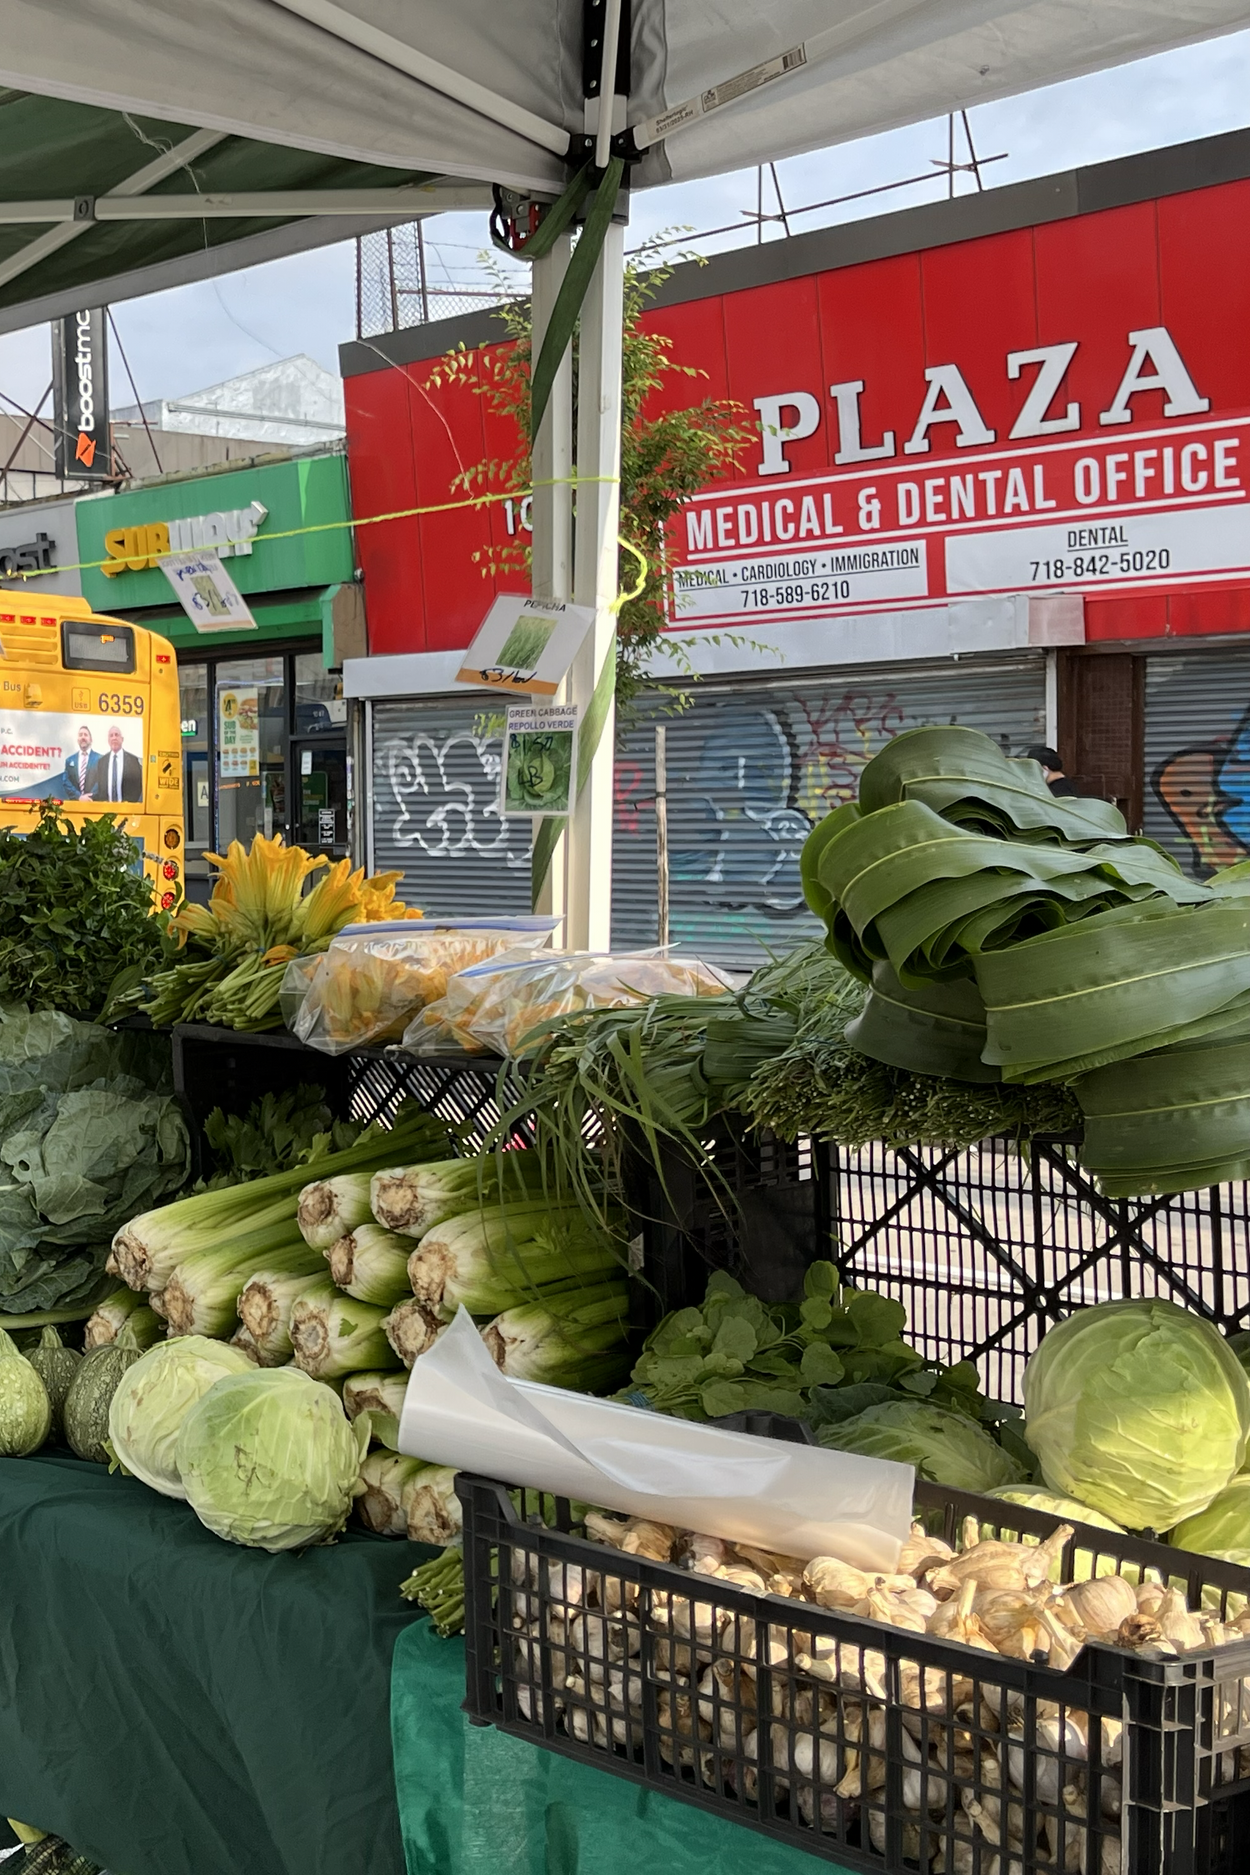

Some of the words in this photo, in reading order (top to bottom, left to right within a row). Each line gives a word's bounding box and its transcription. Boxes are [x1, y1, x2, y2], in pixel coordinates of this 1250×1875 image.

[753, 325, 1211, 476] PLAZA
[686, 493, 843, 551] MEDICAL
[858, 487, 881, 531] &
[897, 465, 1056, 525] DENTAL
[1074, 438, 1241, 504] OFFICE
[101, 500, 268, 578] SUBWAY
[1067, 525, 1128, 548] DENTAL
[678, 568, 729, 589] MEDICAL
[741, 559, 817, 582] CARDIOLOGY
[830, 547, 919, 573] IMMIGRATION
[1030, 549, 1170, 581] 718-842-5020
[741, 580, 850, 608] 718-589-6210
[3, 681, 21, 692] Bus
[98, 693, 144, 715] 6359
[509, 707, 536, 718] GREEN
[538, 705, 577, 717] CABBAGE
[509, 721, 545, 730] REPOLLO
[547, 720, 574, 729] VERDE
[1, 744, 62, 758] ACCIDENT?
[224, 736, 236, 745] DAY
[9, 761, 50, 770] ACCIDENTE?
